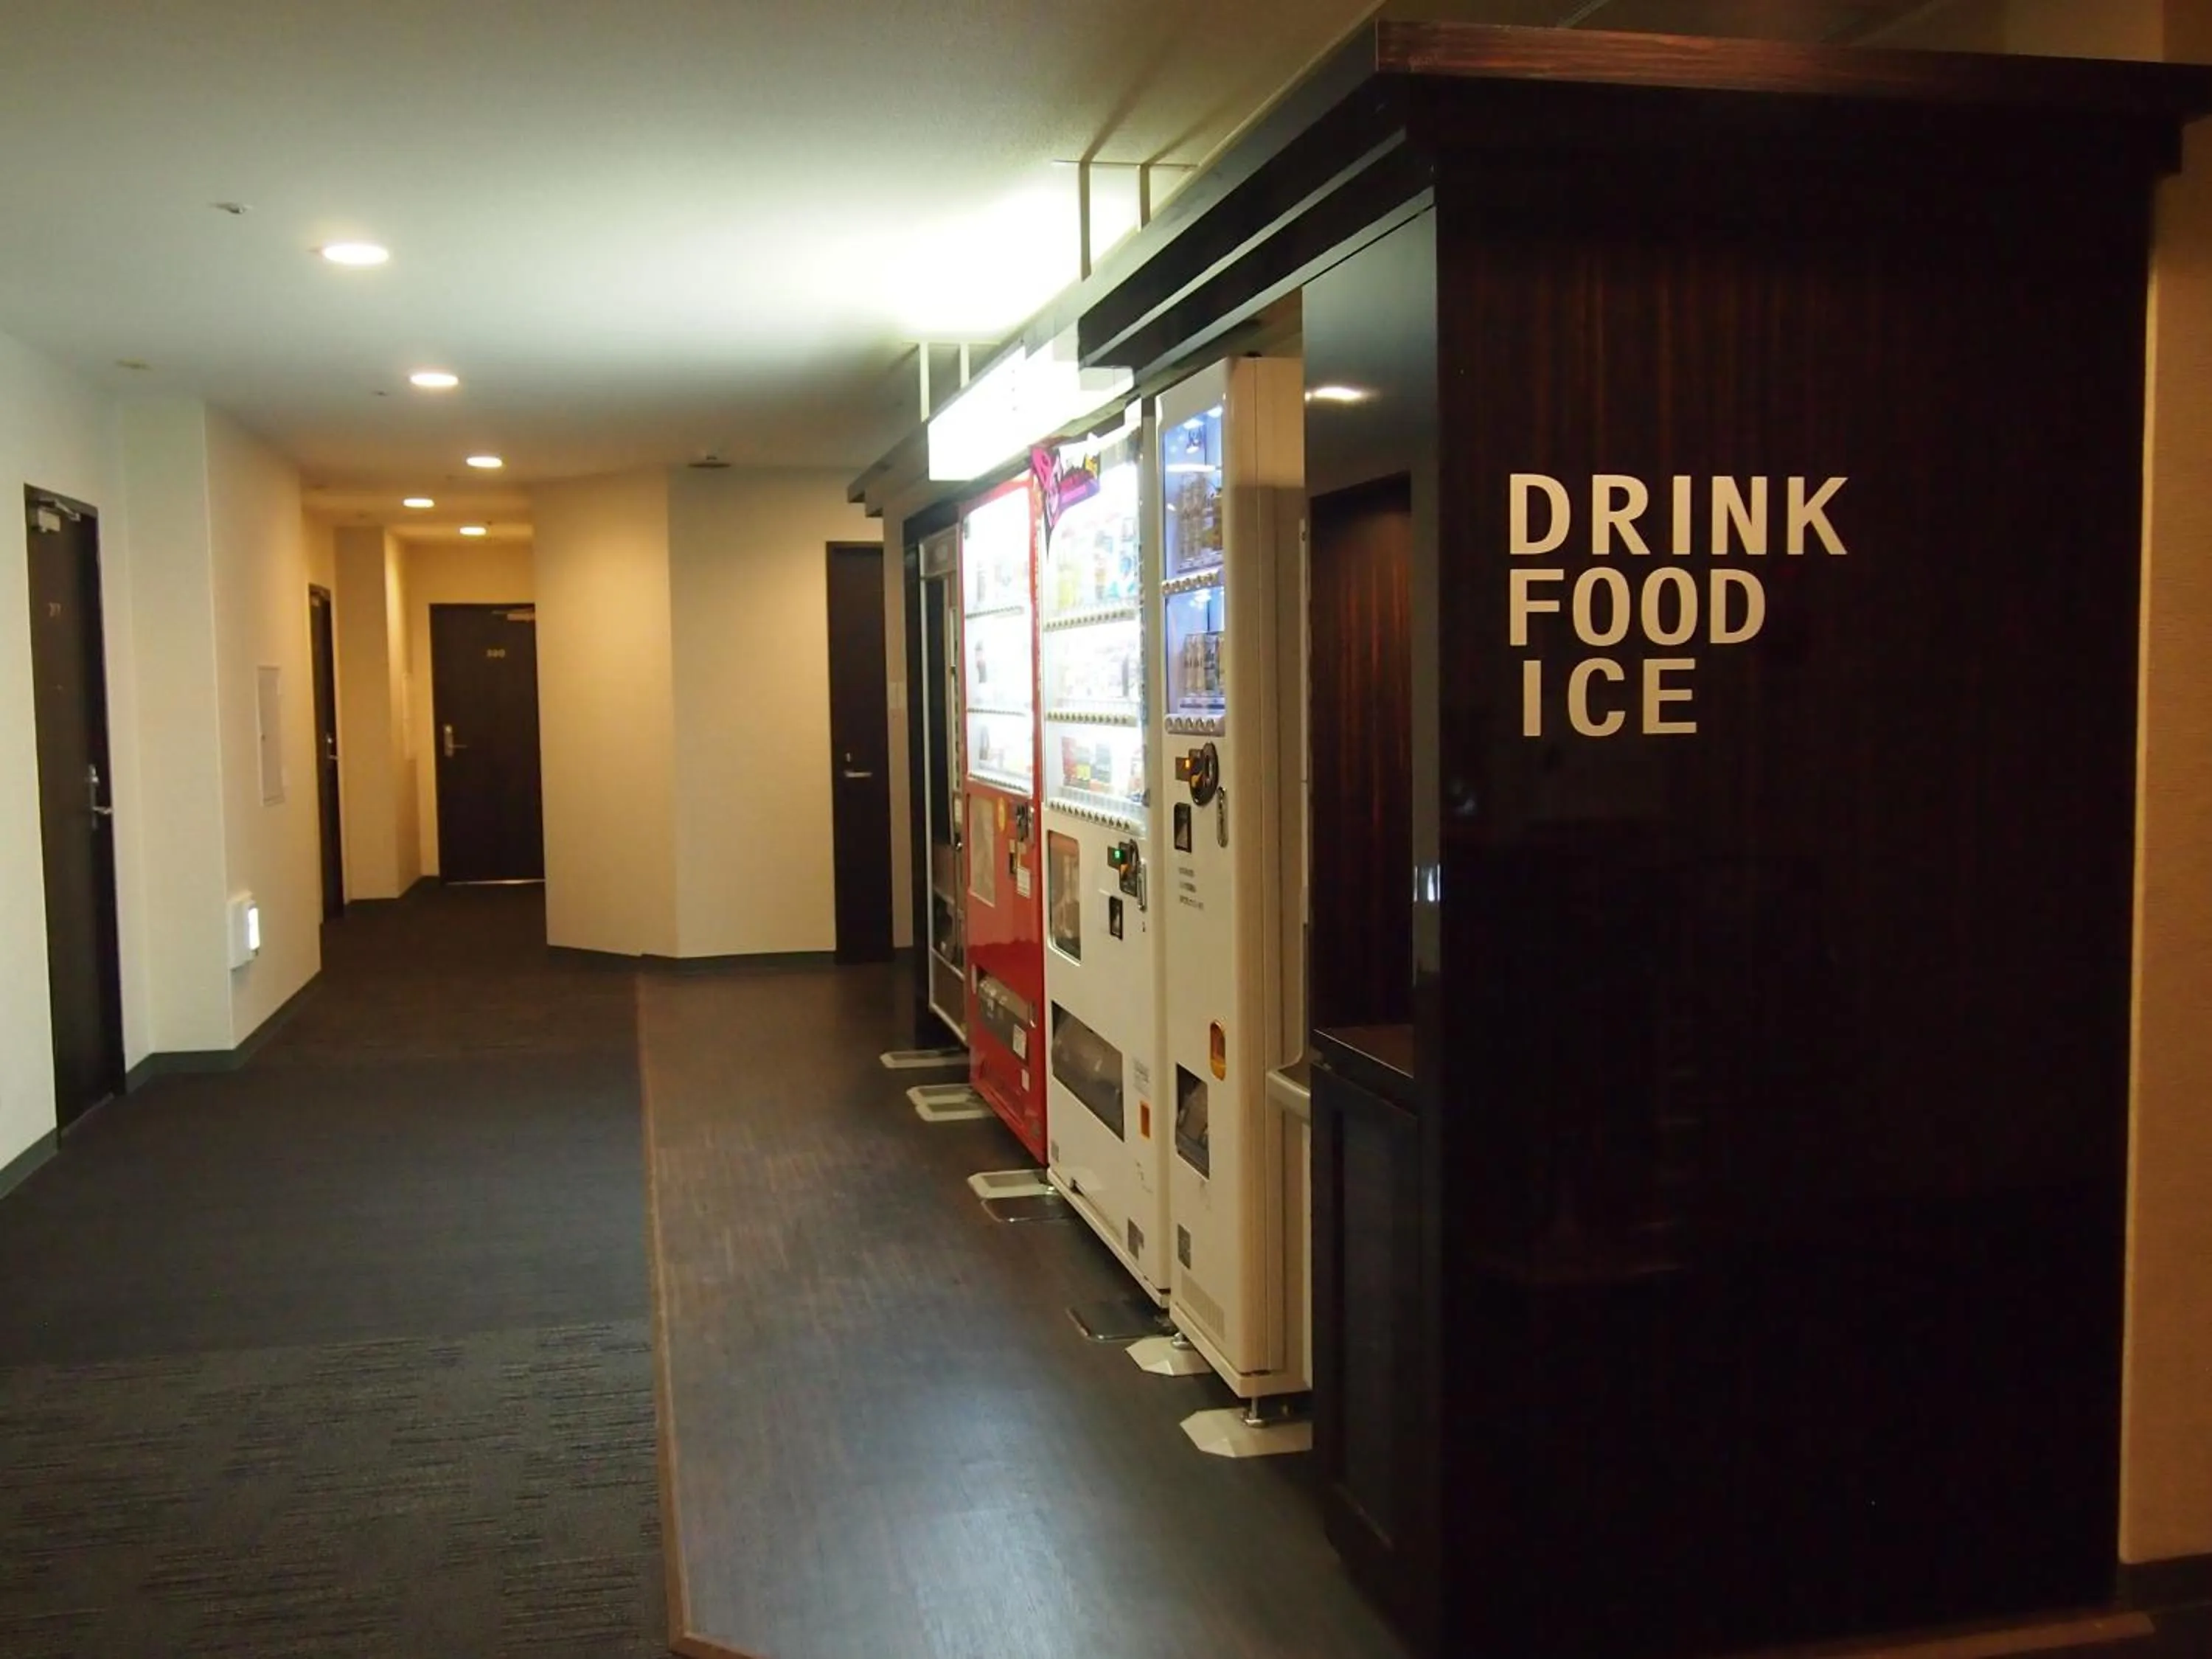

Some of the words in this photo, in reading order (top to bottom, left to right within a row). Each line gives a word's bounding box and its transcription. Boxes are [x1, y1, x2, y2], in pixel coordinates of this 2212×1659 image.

[1510, 473, 1848, 554] DRINK
[1510, 567, 1765, 646] FOOD
[1523, 658, 1697, 737] ICE
